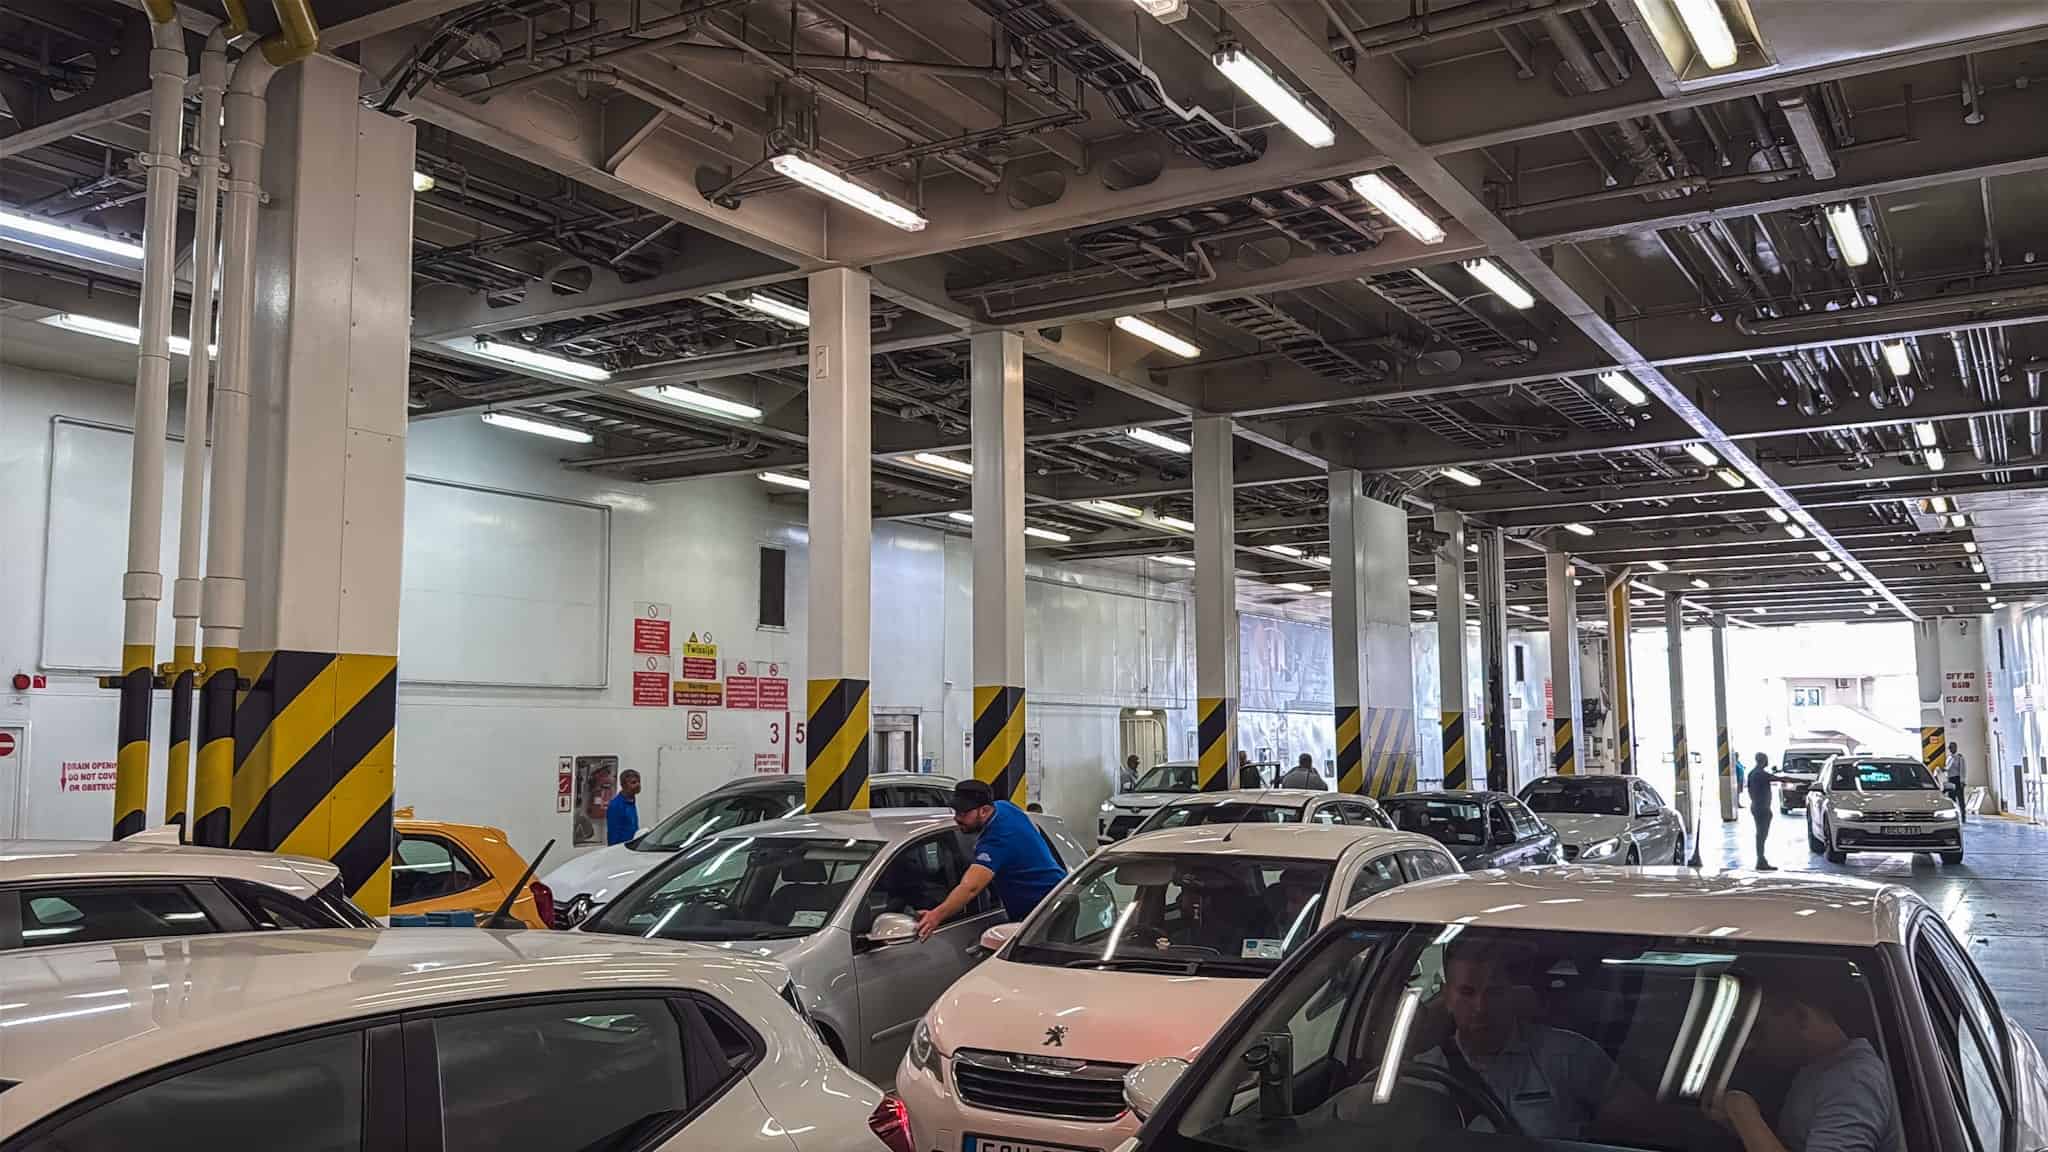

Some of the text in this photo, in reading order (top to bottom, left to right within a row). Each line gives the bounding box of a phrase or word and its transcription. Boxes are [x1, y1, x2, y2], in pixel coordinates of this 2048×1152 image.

[770, 722, 780, 744] 3
[795, 722, 805, 744] 5
[67, 762, 90, 770] DRAIN
[68, 773, 78, 781] DO
[69, 784, 80, 792] OR
